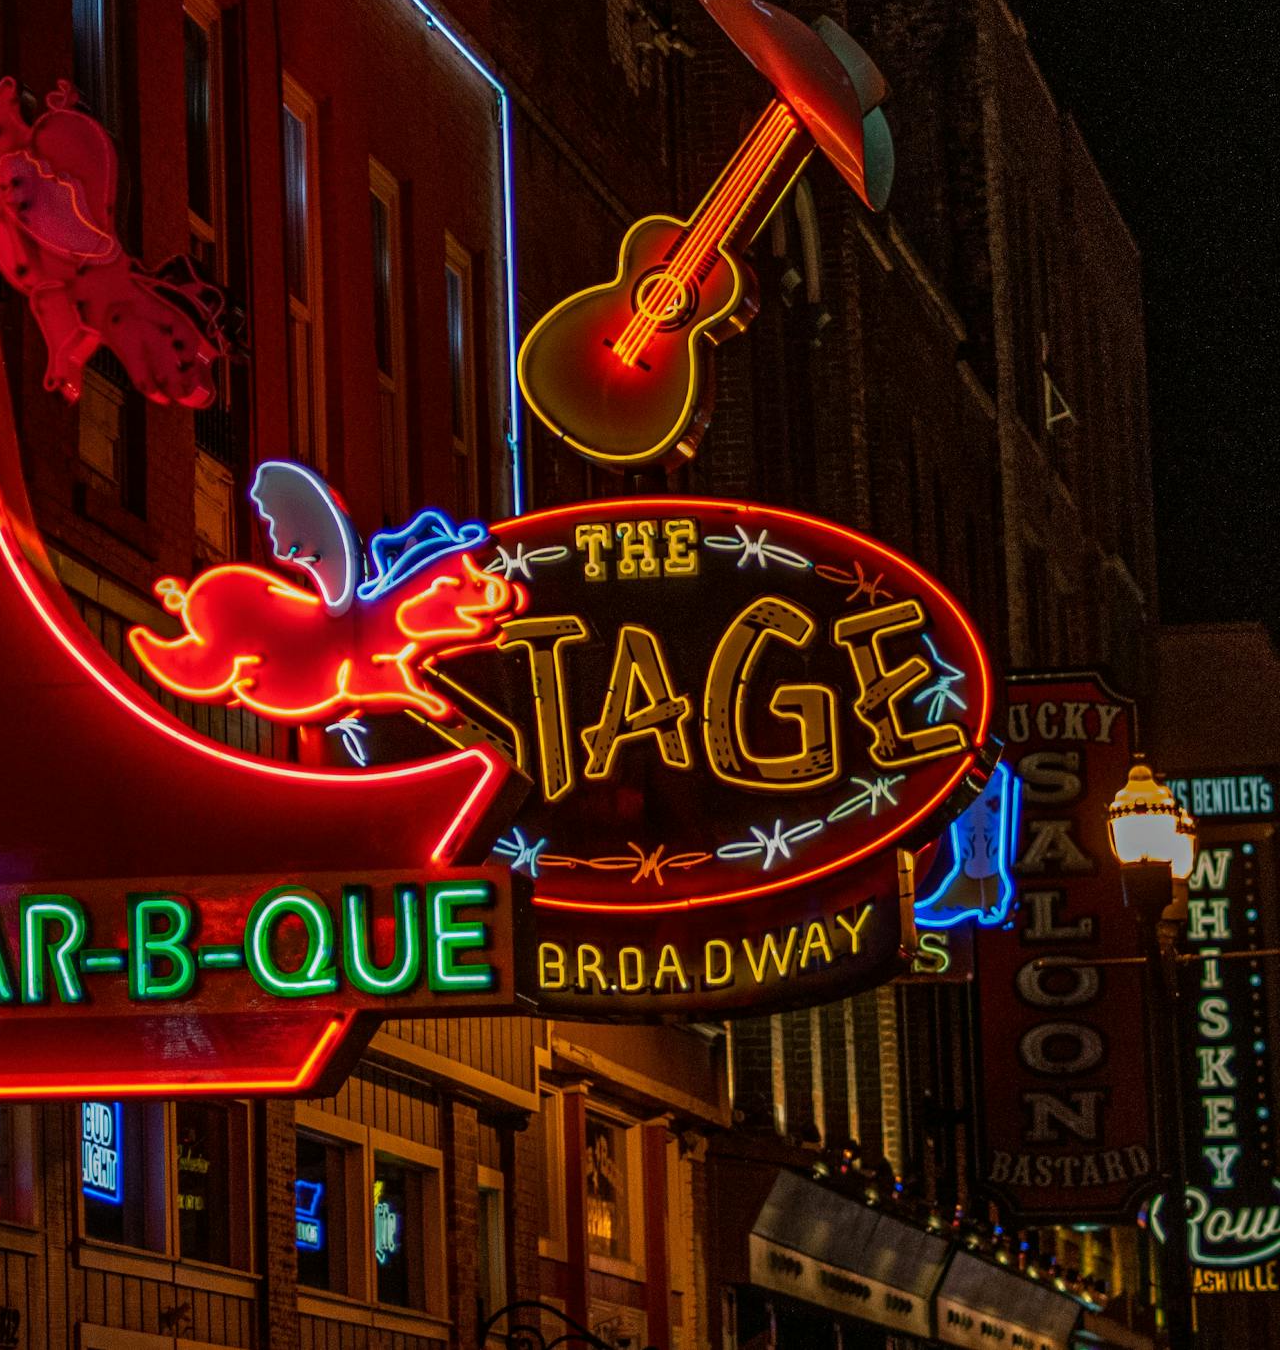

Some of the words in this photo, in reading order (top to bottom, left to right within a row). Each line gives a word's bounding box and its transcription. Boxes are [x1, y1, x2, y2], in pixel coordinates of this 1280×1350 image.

[574, 519, 700, 581] THE
[538, 904, 873, 994] BROADWAY
[1013, 747, 1105, 1144] SALOON
[1187, 848, 1243, 1190] WHISKEY
[82, 1102, 113, 1147] BUD
[989, 1143, 1150, 1189] BASTARD
